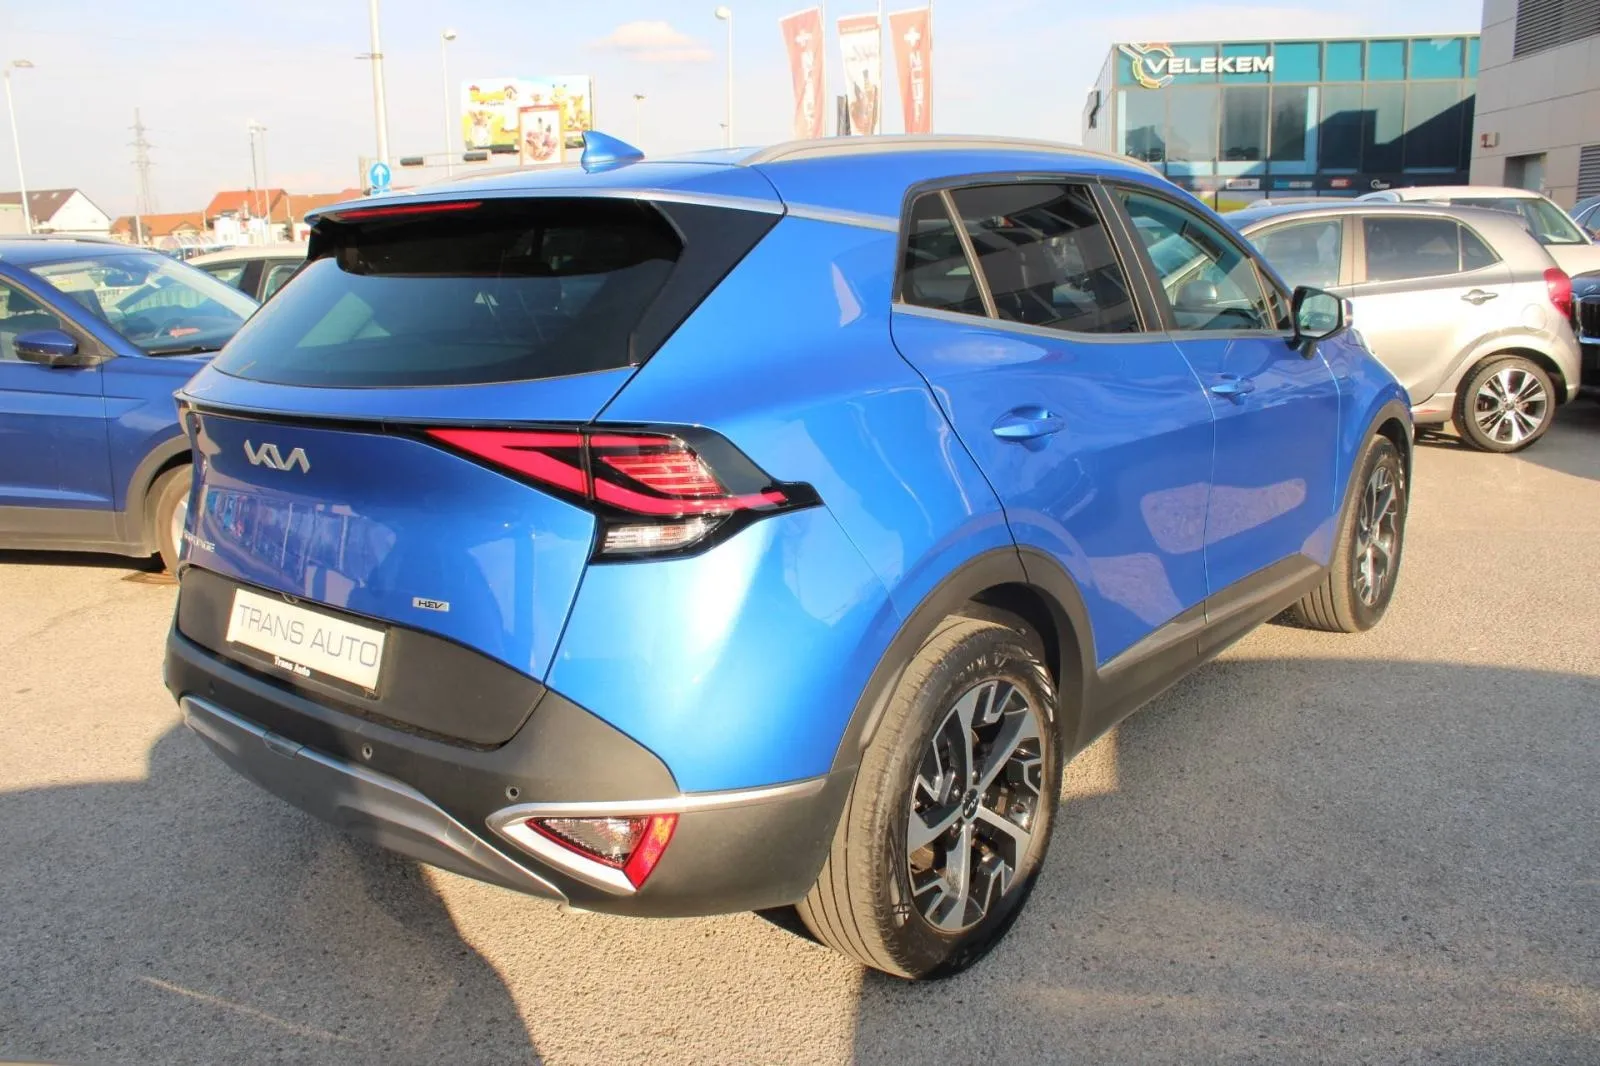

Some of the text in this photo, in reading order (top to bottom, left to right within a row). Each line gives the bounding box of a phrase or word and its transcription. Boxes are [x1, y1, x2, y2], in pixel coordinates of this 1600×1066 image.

[1145, 55, 1274, 74] VELEKEM
[418, 599, 444, 609] HEV
[239, 604, 378, 667] TRANS AUTO
[274, 655, 311, 677] Trans Auto
